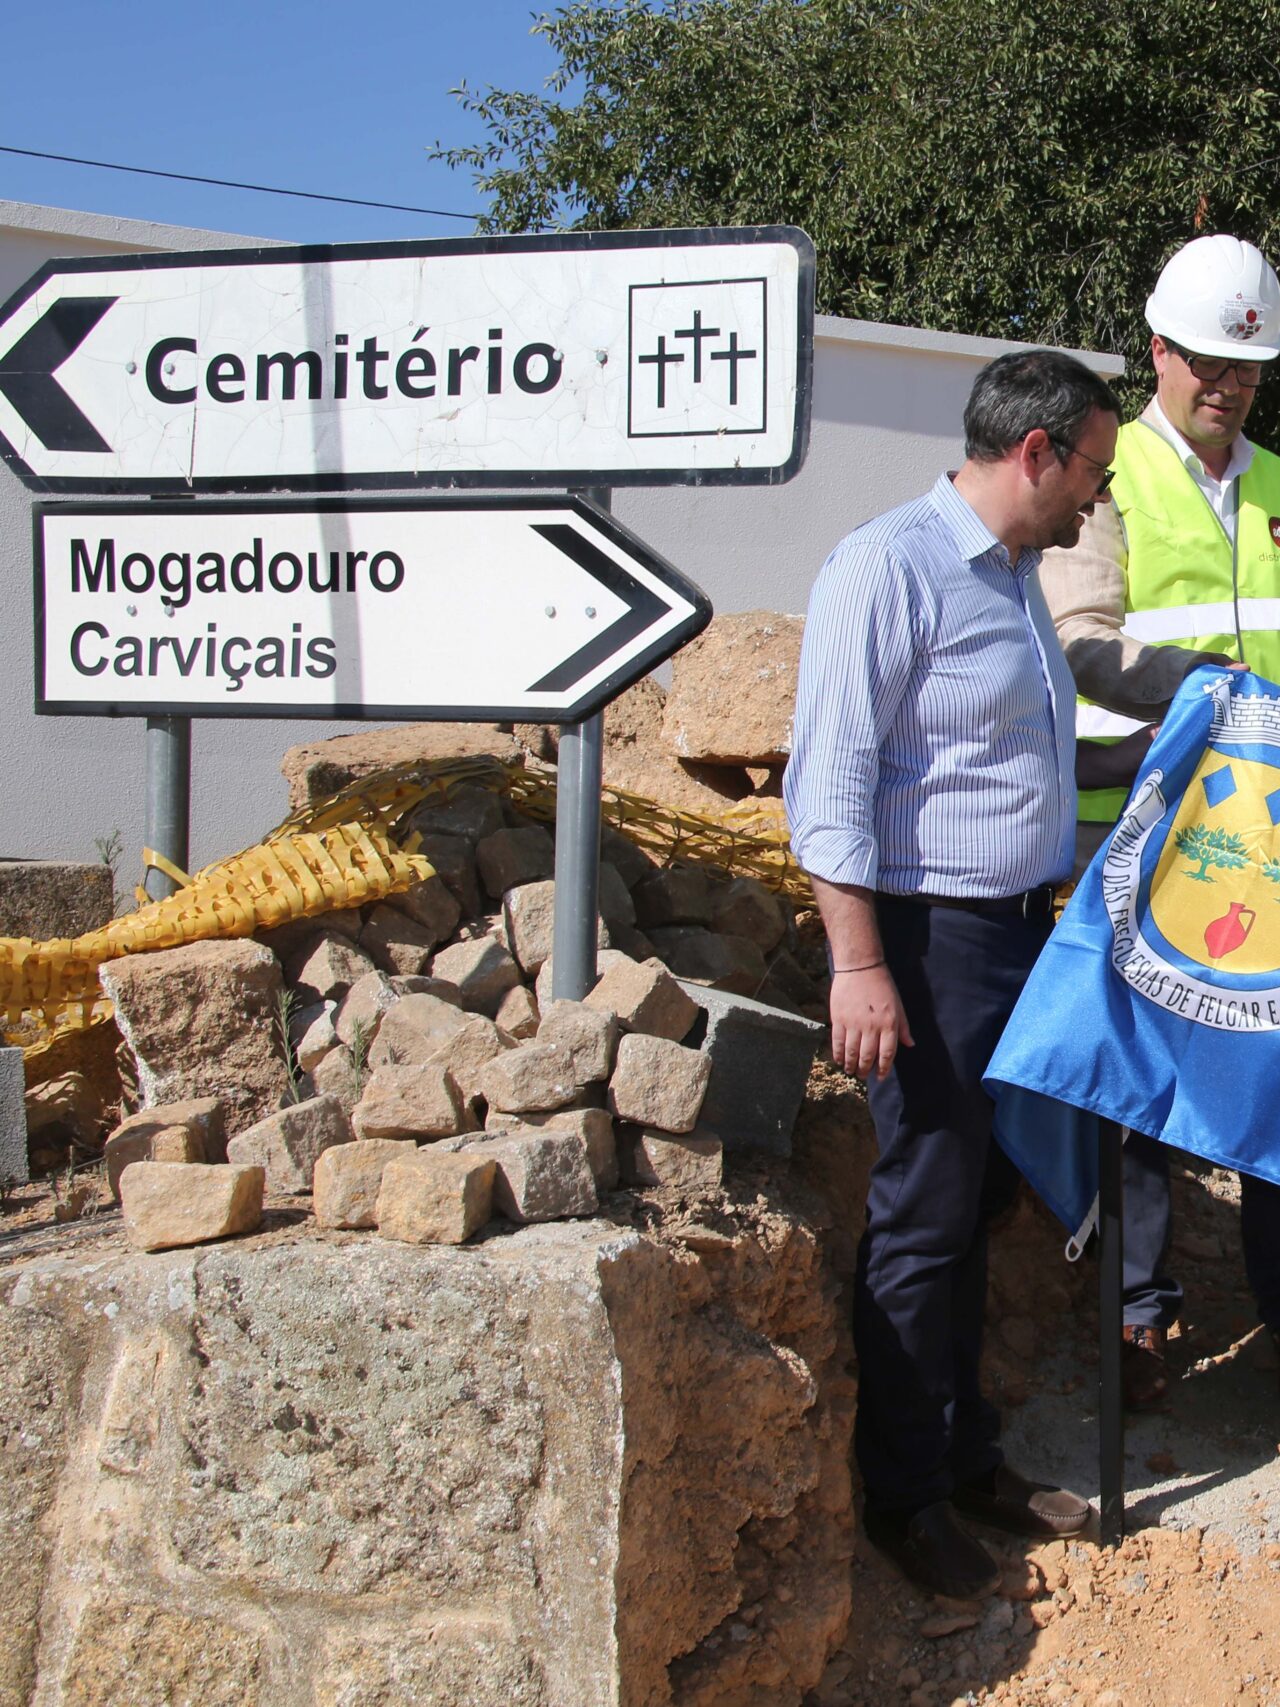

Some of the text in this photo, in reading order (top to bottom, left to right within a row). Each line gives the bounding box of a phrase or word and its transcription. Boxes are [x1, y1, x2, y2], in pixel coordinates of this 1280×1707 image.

[145, 327, 563, 404] Cemitério
[70, 538, 405, 608] Mogadouro
[70, 621, 337, 692] Carviçais
[1106, 815, 1146, 869] UNIÃO
[1103, 874, 1131, 903] DAS
[1110, 908, 1170, 998] FREGUESIAS
[1166, 982, 1194, 1013] DE
[1195, 993, 1263, 1029] FELGAR
[1269, 1000, 1280, 1025] E
